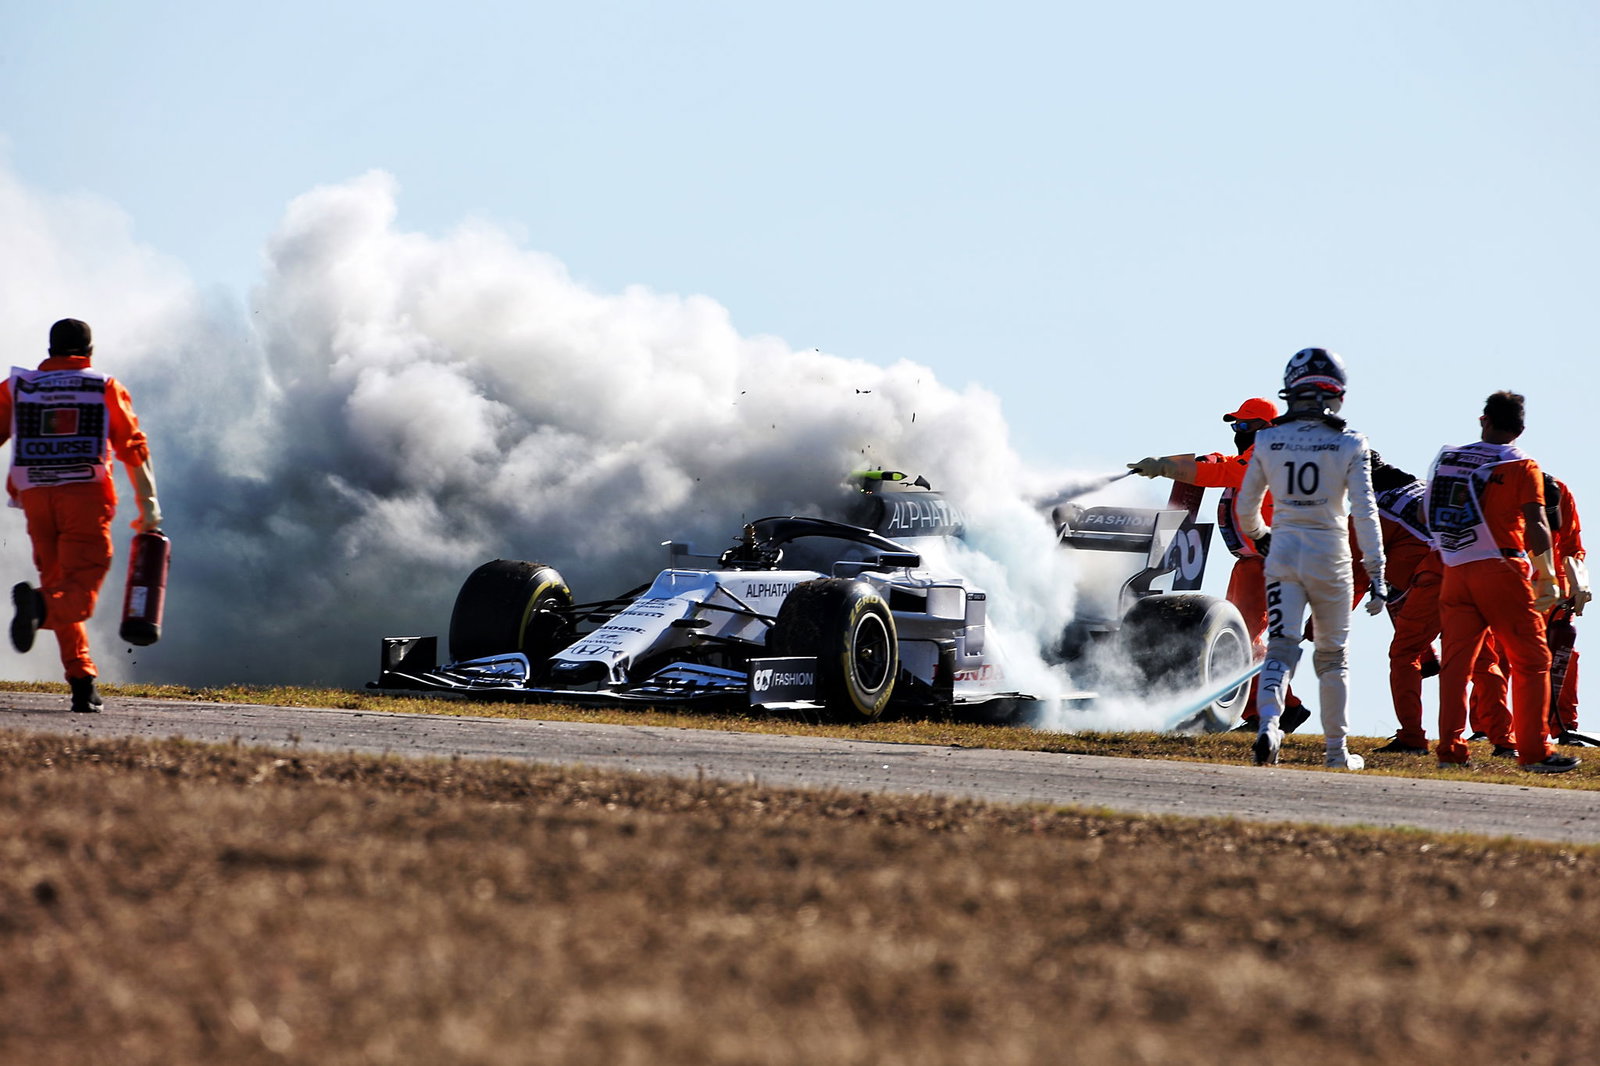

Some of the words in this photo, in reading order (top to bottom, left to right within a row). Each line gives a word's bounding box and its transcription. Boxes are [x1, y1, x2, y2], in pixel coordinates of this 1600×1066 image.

[26, 441, 93, 456] COURSE
[1284, 461, 1320, 495] 10
[746, 583, 798, 598] ALPHATAU
